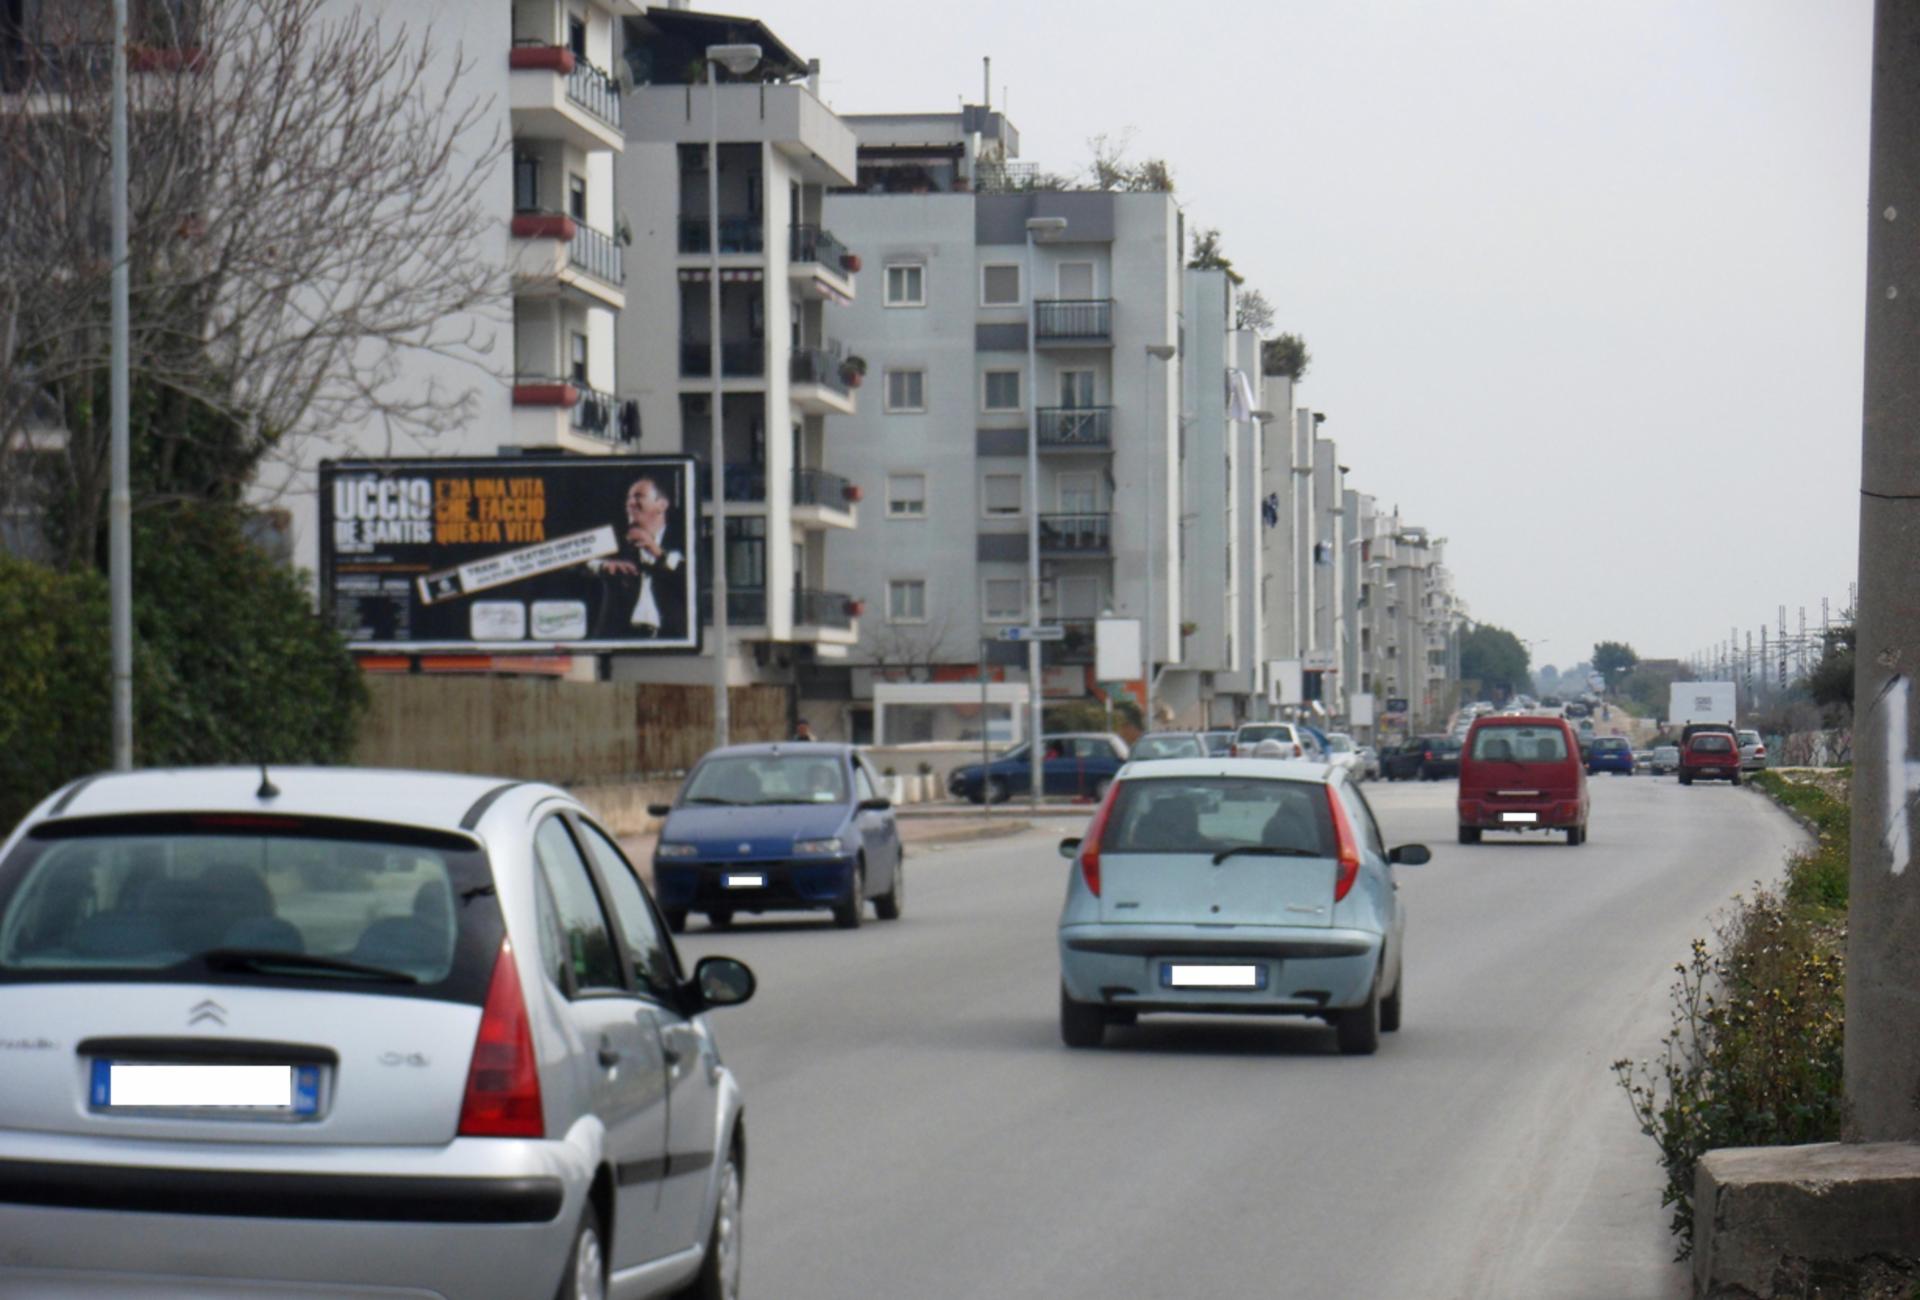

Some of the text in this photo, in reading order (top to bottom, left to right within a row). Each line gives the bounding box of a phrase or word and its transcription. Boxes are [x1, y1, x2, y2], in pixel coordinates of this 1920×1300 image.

[334, 478, 431, 520] UCCIO
[509, 478, 545, 498] VITA
[479, 498, 545, 521] FACCIO
[361, 521, 431, 544] SANTIS
[435, 521, 545, 545] QUESTA VITA
